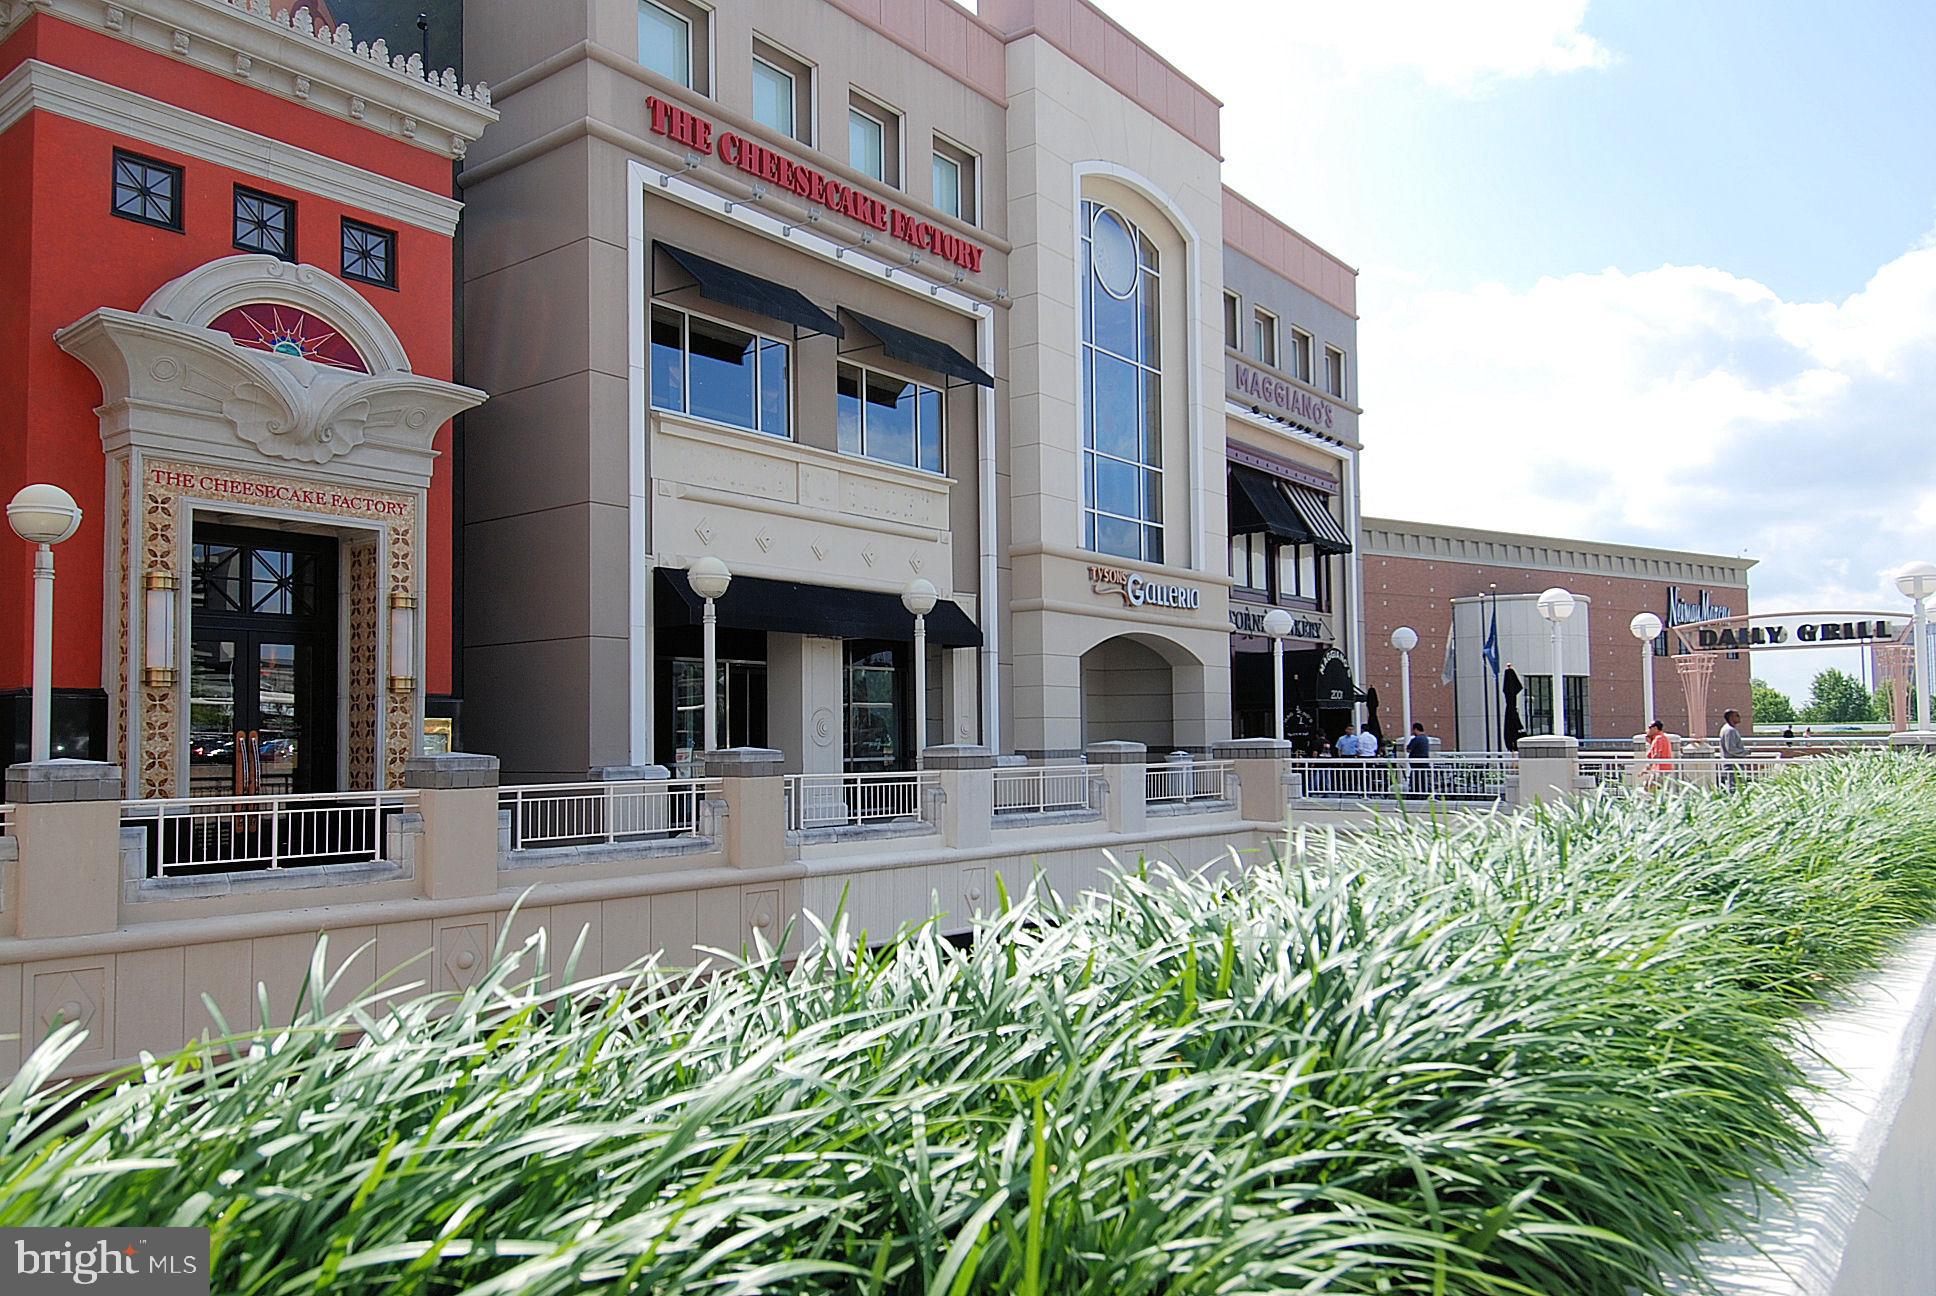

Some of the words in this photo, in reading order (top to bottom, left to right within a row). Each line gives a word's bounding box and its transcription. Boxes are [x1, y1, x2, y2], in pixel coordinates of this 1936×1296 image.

[646, 96, 712, 155] THE
[718, 131, 888, 232] CHEESECAKE
[891, 208, 984, 273] FACTORY
[1236, 364, 1334, 428] MAGGIANO'S
[151, 469, 195, 488] THE
[200, 476, 326, 506] CHEESECAKE
[331, 494, 408, 515] FACTORY
[1090, 566, 1127, 584] TYSONS
[1699, 626, 1786, 647] DAILY
[1797, 620, 1892, 642] GRILL
